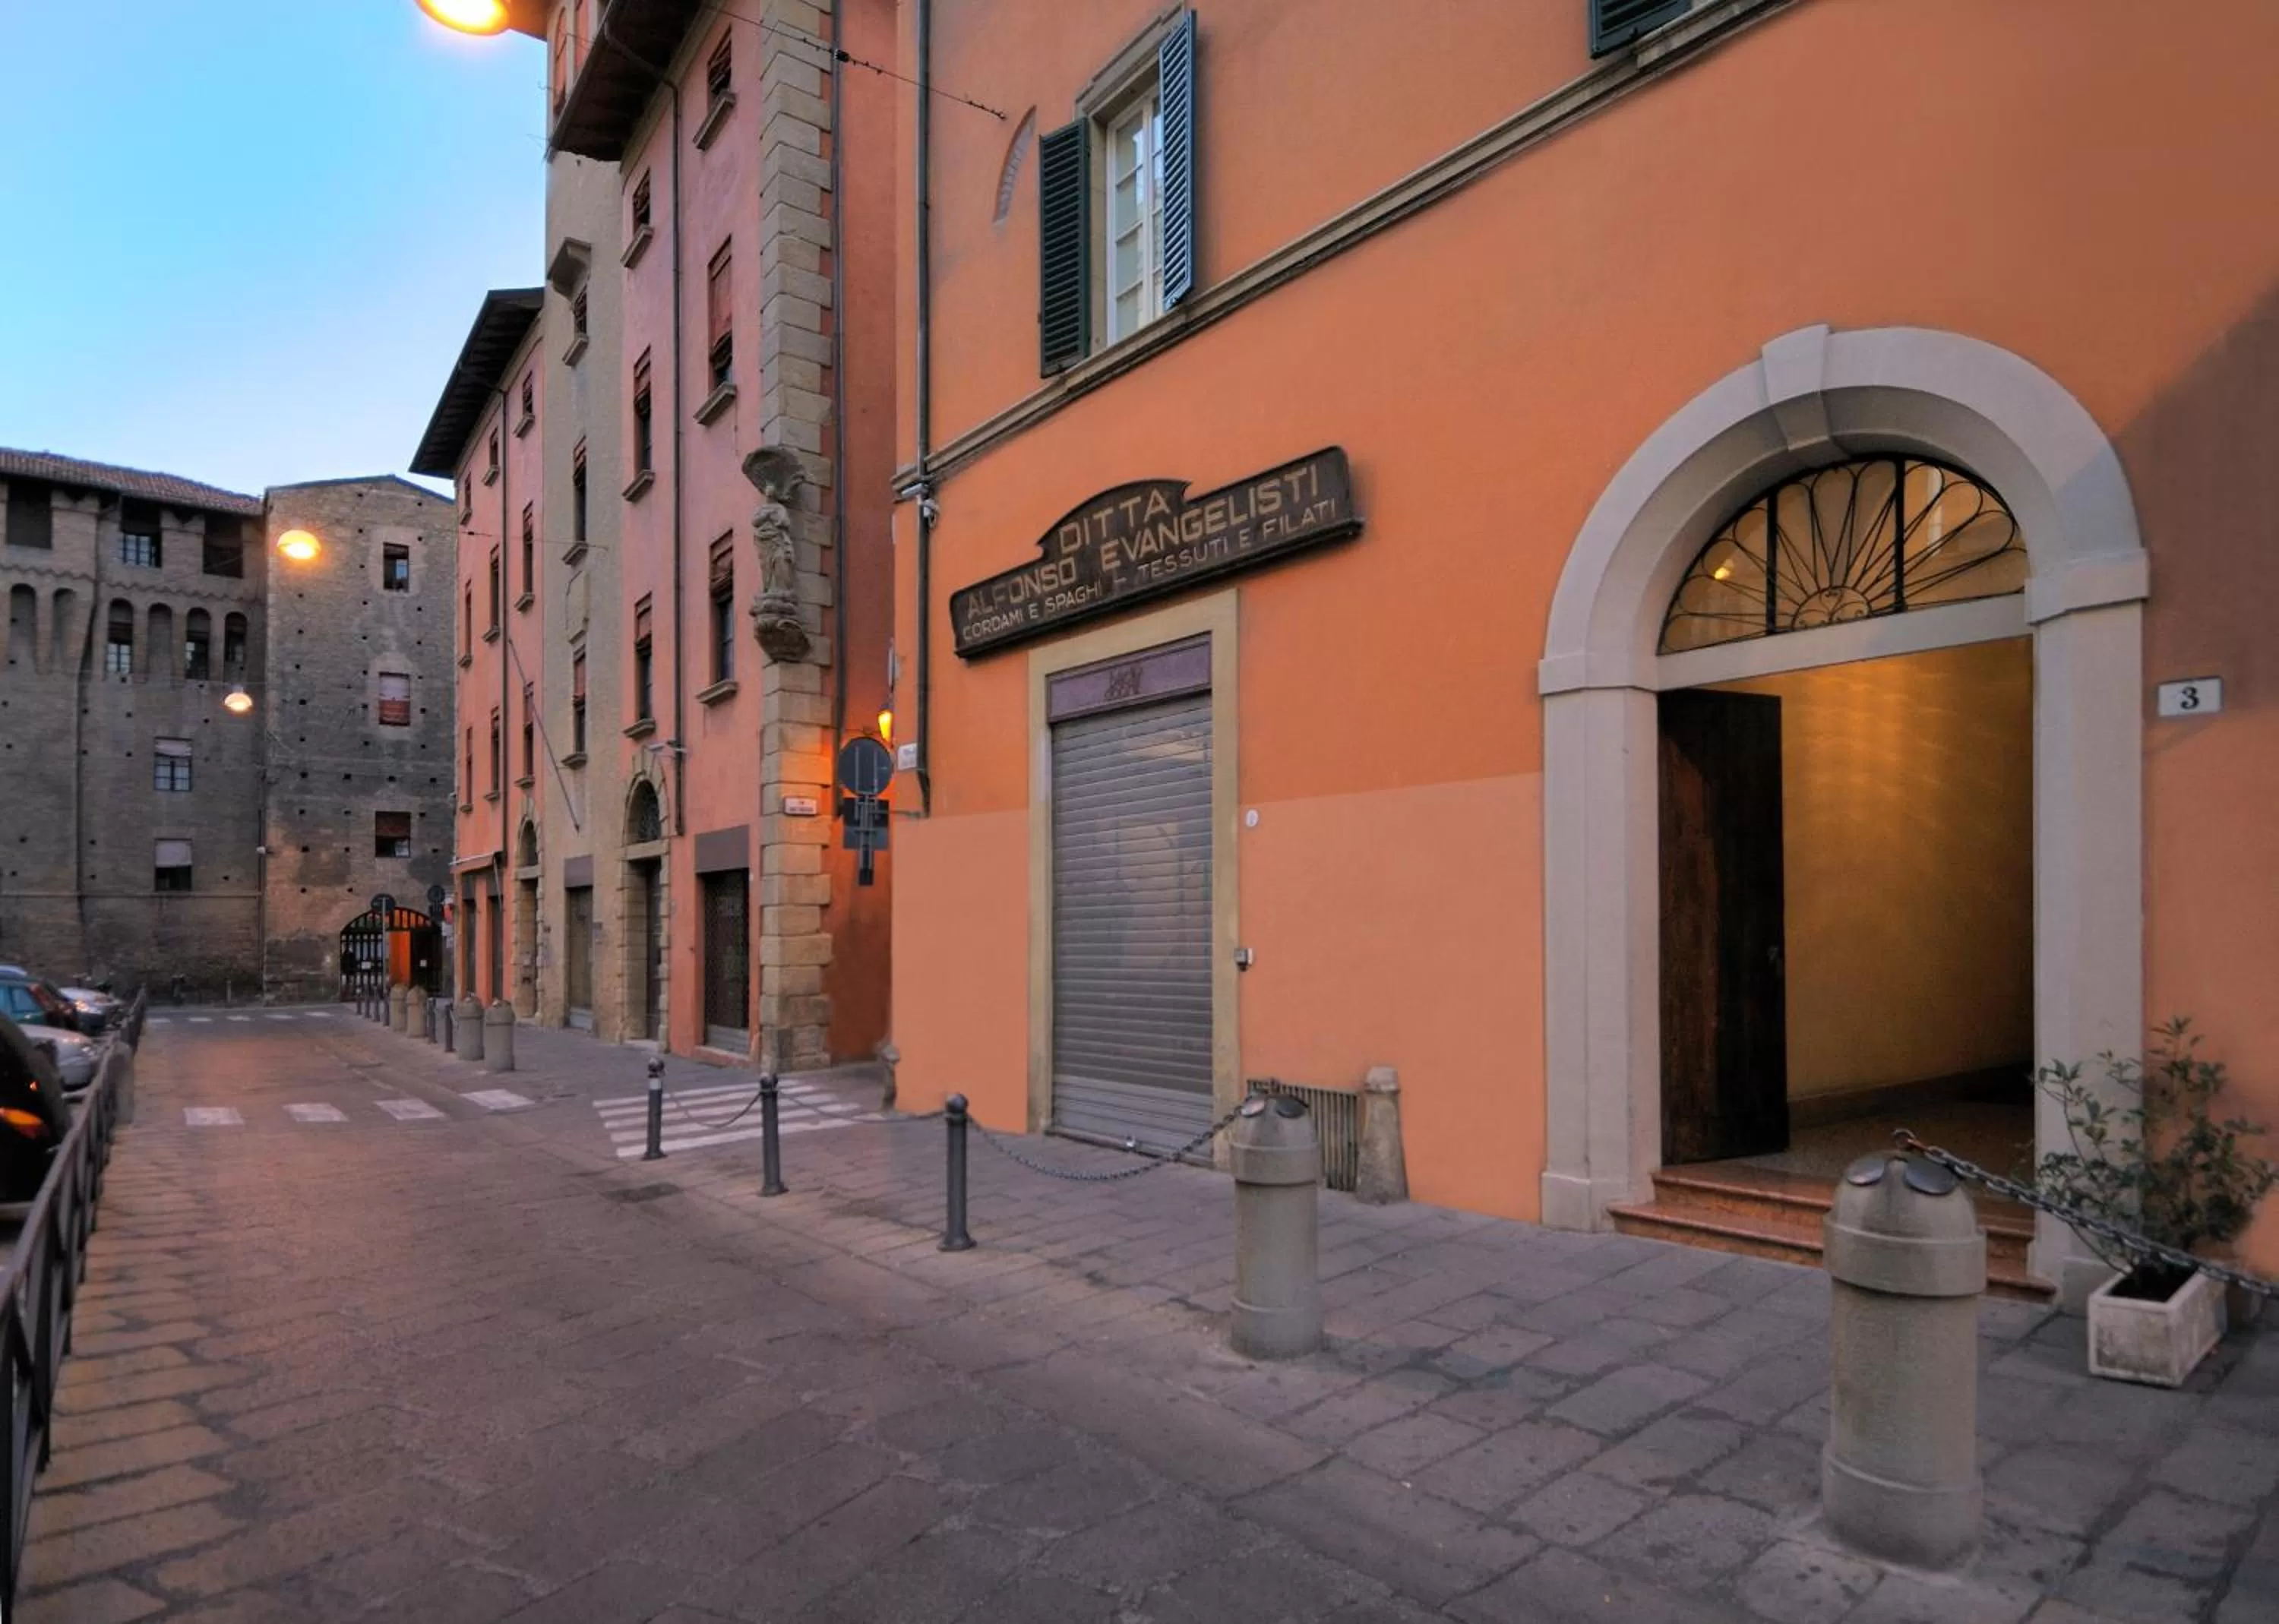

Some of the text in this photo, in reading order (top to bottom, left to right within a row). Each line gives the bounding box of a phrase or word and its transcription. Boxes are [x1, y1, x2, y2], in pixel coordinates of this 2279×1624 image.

[962, 608, 1024, 641] CORDAMI
[1028, 603, 1038, 620] E
[1045, 580, 1102, 613] SPAGHI
[1137, 537, 1228, 580] TESSUTI
[1239, 527, 1251, 548] E
[1262, 498, 1336, 540] FILATI
[966, 464, 1318, 620] ALFONSO EVANGELISTI
[1059, 488, 1171, 554] DITTA
[2180, 686, 2200, 710] 3
